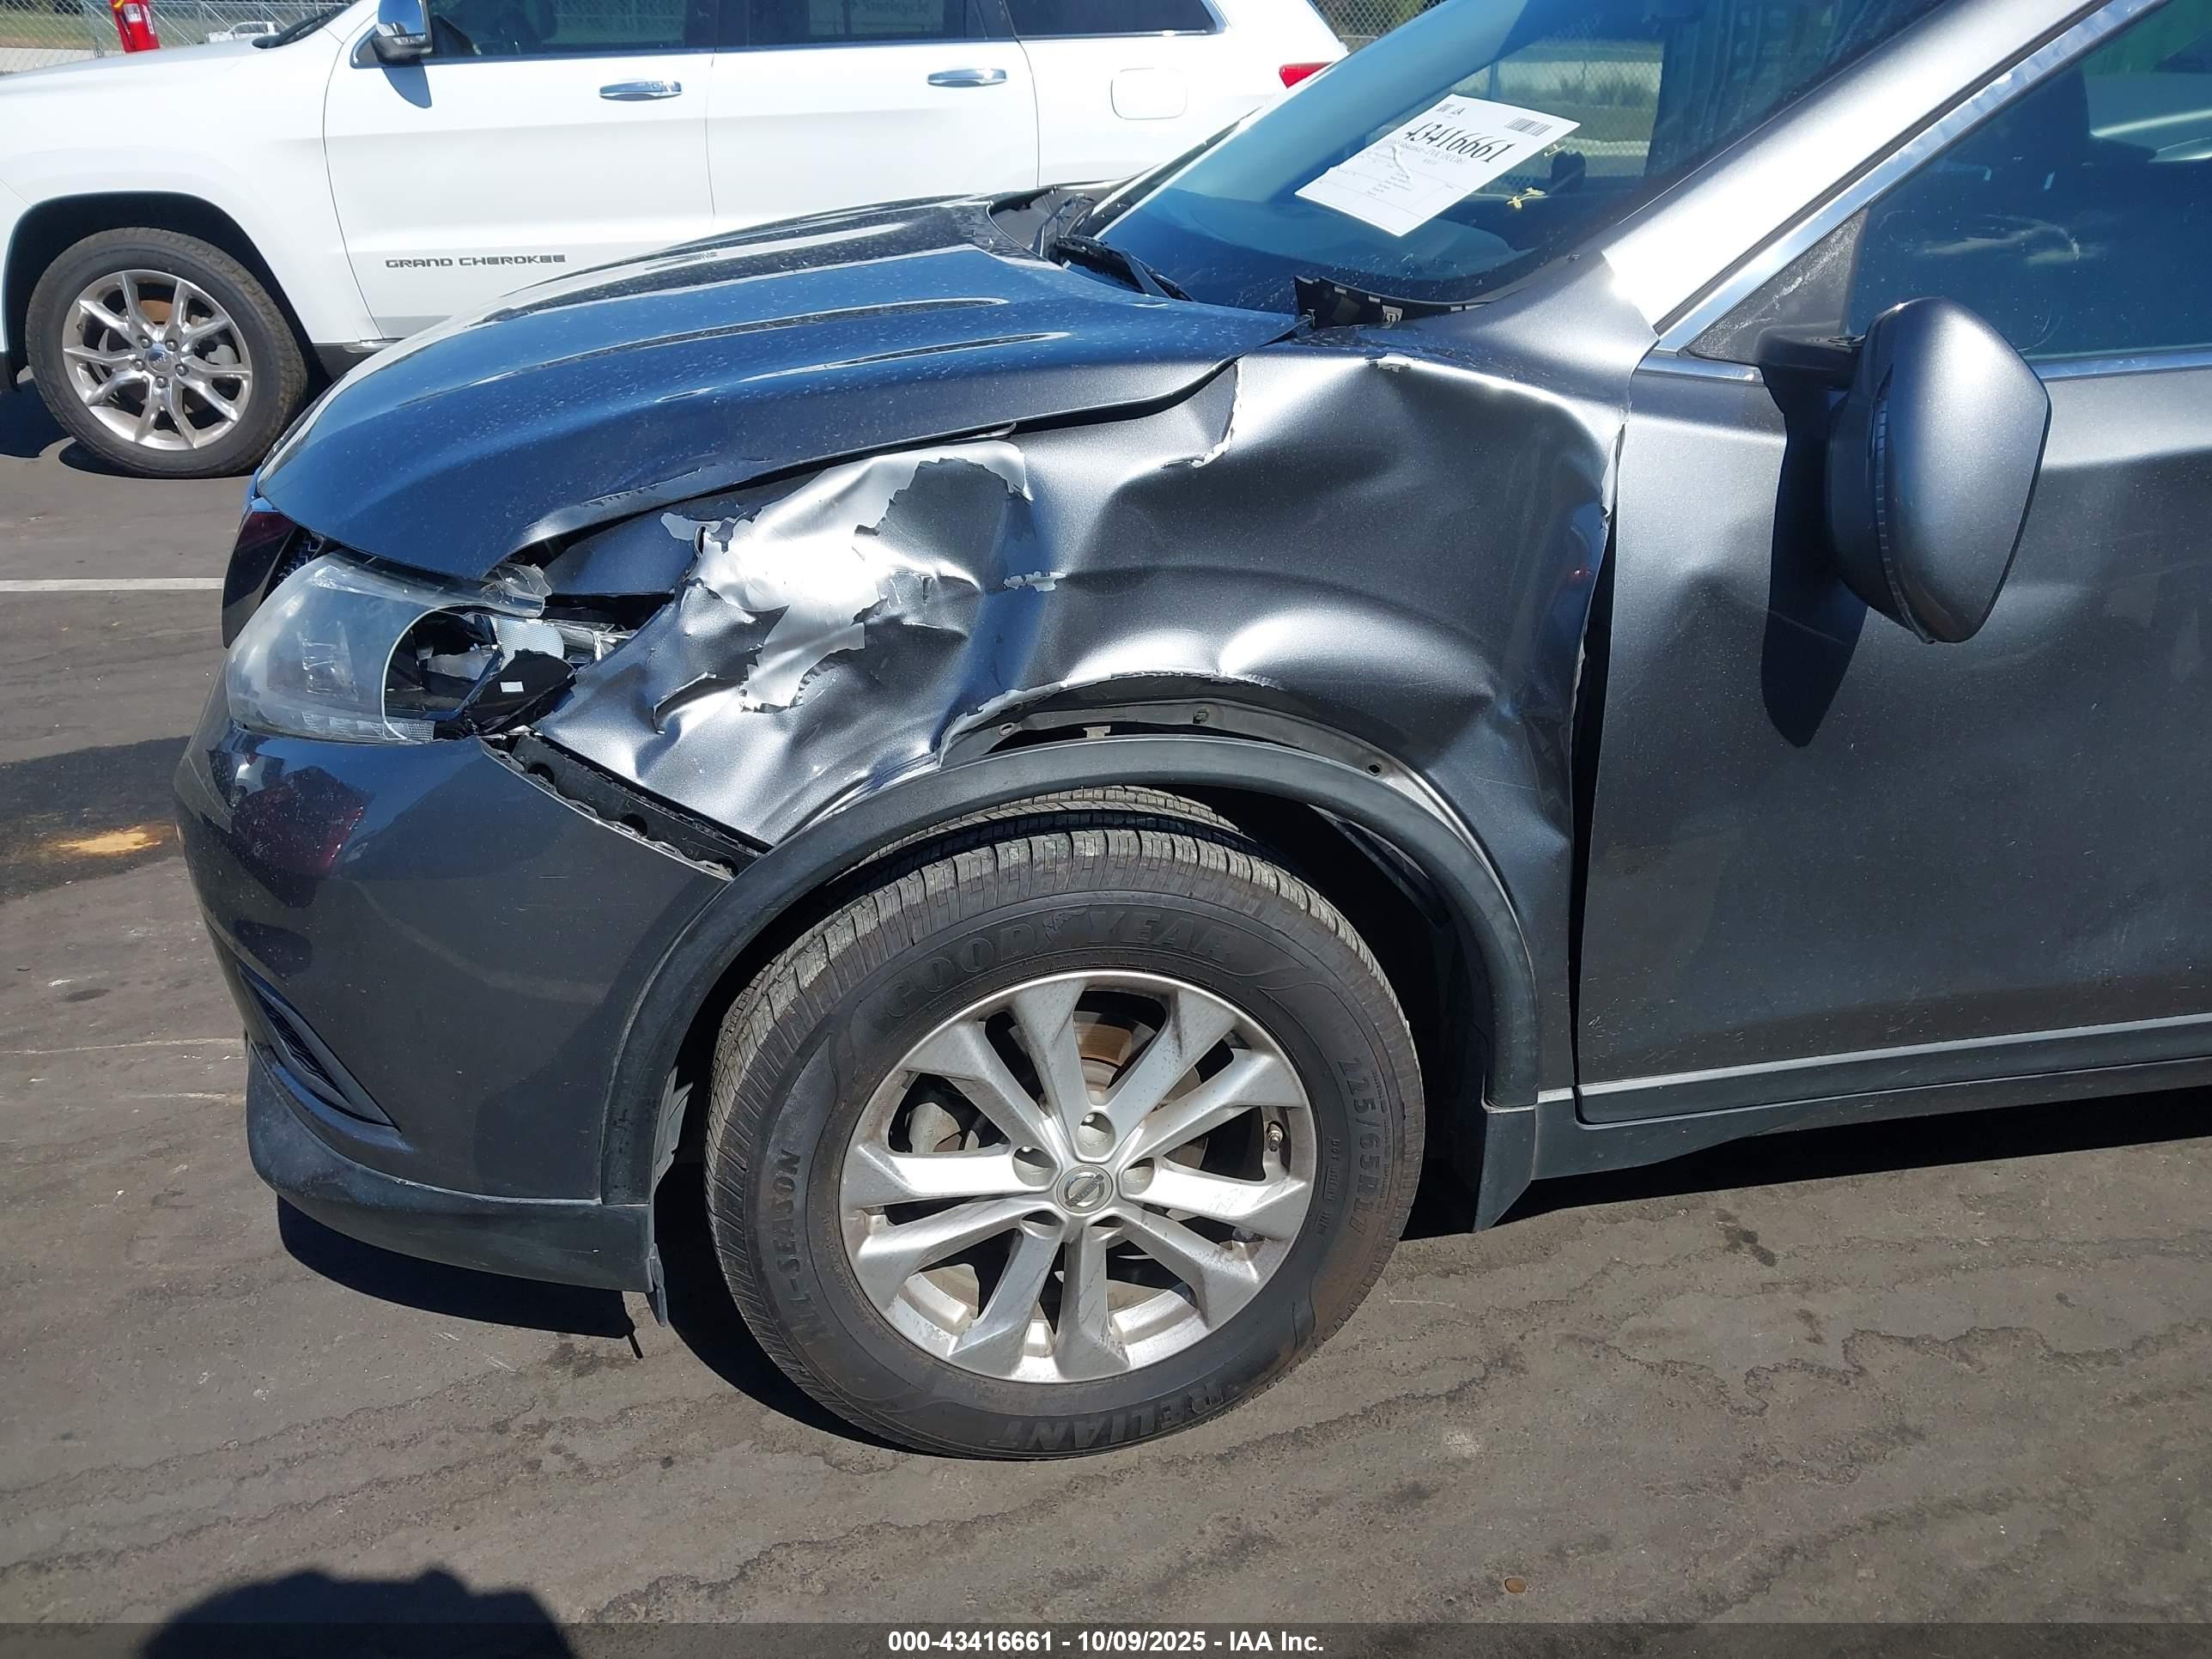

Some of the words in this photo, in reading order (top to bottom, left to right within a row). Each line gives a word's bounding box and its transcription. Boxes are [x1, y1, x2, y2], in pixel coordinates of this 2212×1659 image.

[1404, 122, 1515, 163] 43416661
[385, 258, 453, 268] GRAND
[459, 254, 566, 266] CHEROKEE
[1338, 1058, 1381, 1236] 225/65R17
